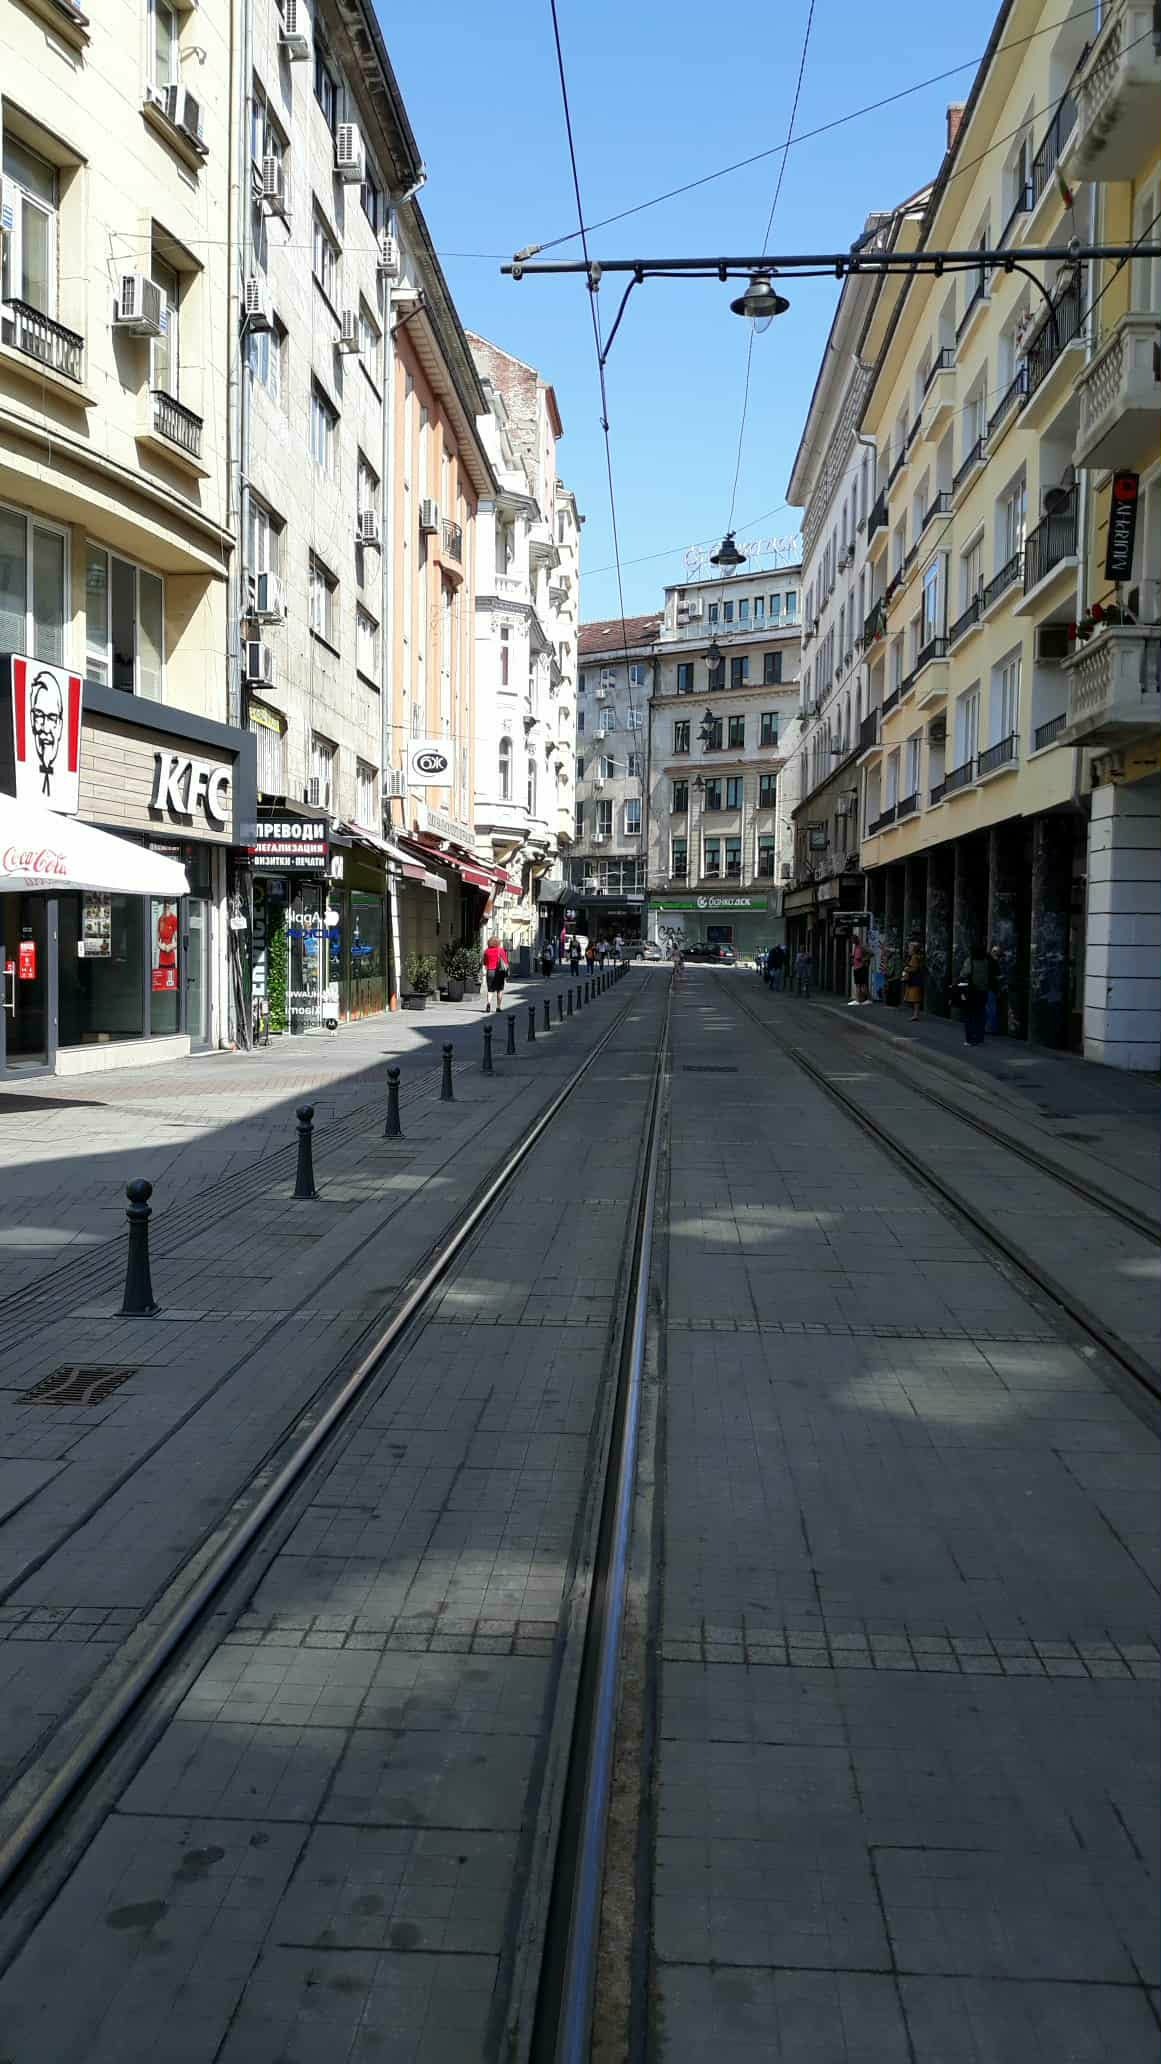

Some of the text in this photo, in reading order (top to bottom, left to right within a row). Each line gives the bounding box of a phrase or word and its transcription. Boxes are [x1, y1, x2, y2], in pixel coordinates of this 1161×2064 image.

[1112, 501, 1132, 570] MURPHY
[154, 751, 233, 822] KFC
[256, 823, 324, 841] ПРЕВОДИ
[255, 843, 324, 854] ЛЕГАЛИЗАЦИЯ
[296, 857, 325, 867] ПЕЧАТИ
